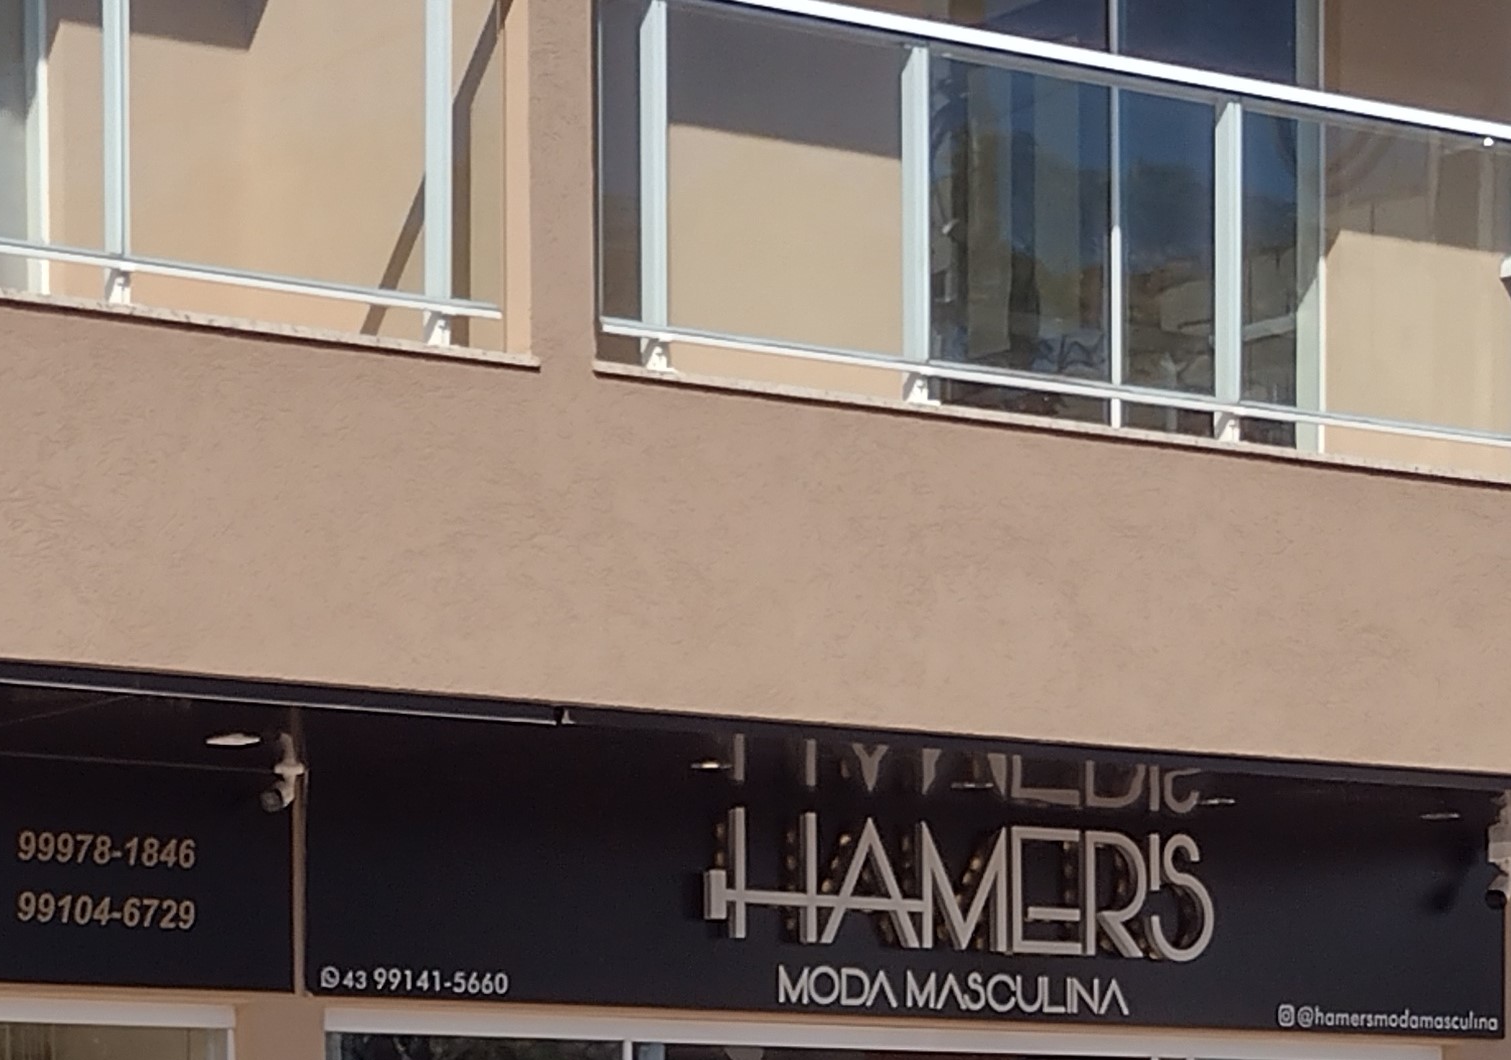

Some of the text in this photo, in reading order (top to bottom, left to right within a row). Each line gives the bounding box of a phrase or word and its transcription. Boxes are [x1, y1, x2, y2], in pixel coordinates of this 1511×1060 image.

[18, 830, 196, 868] 99978-1846
[17, 891, 196, 930] 99104-6729
[342, 967, 509, 994] 43 99141-5660
[778, 964, 1130, 1016] MODA MASCULINA
[1296, 1005, 1499, 1031] @hamersmodamasculina
